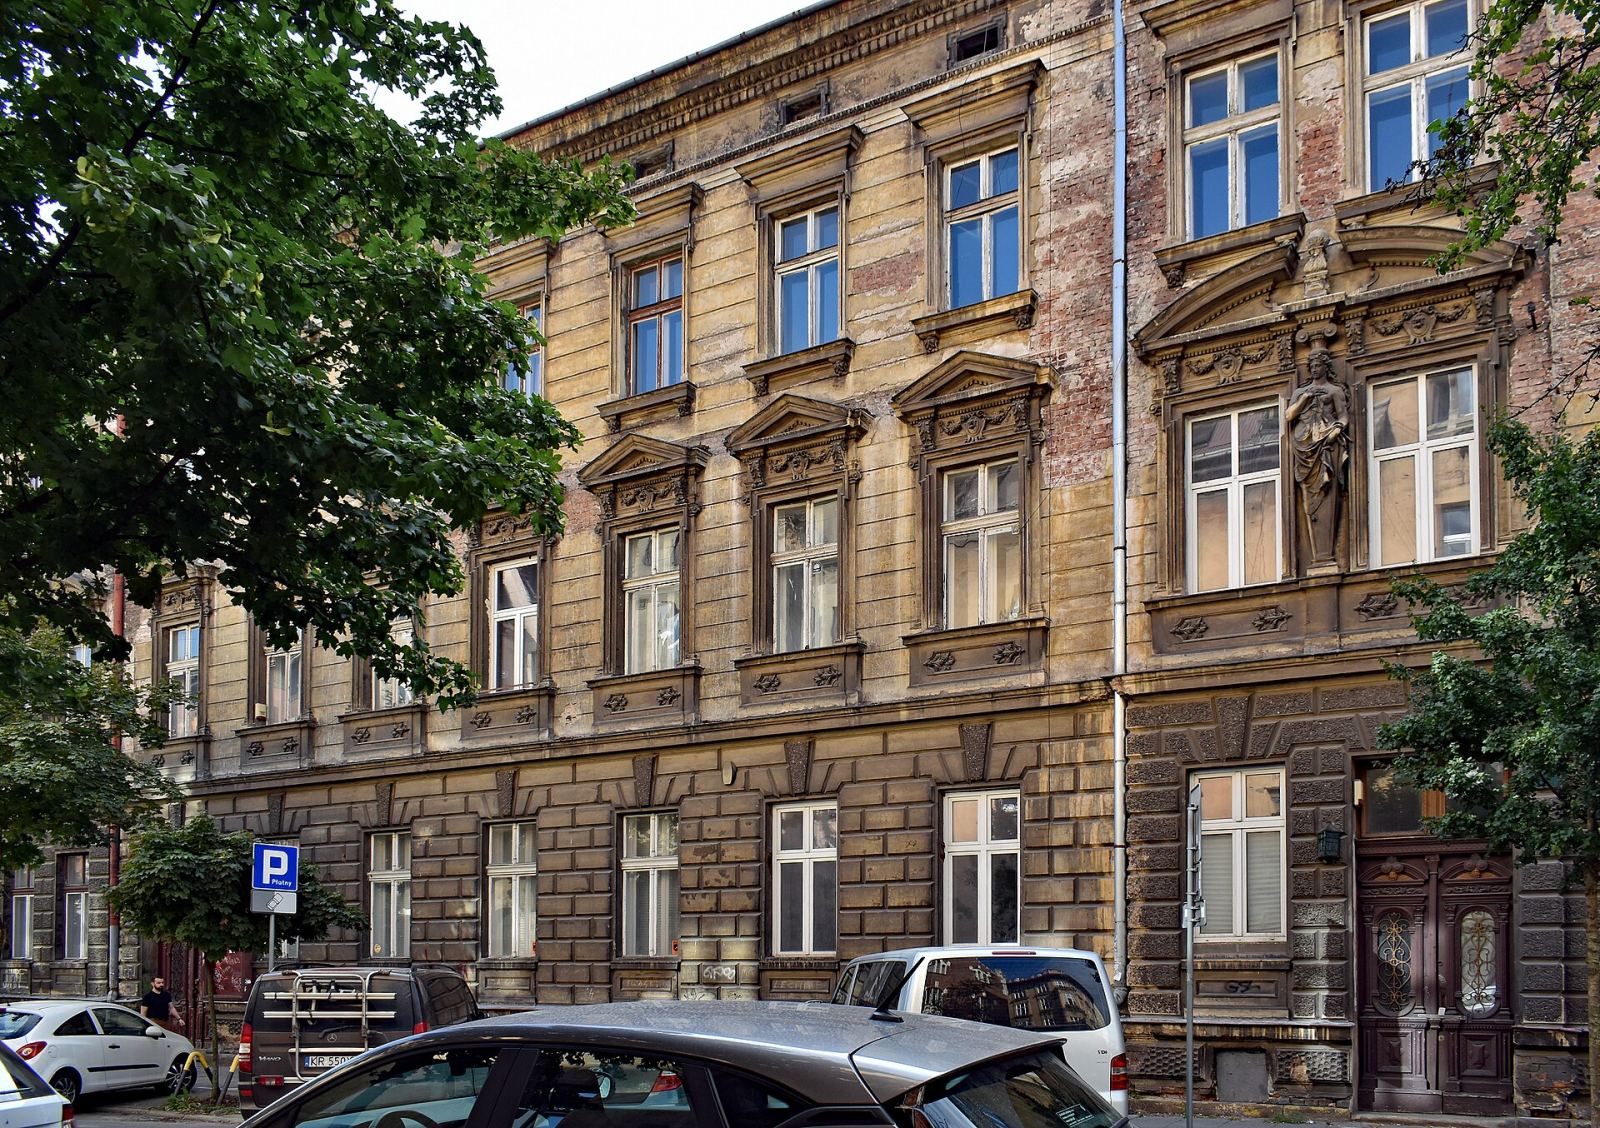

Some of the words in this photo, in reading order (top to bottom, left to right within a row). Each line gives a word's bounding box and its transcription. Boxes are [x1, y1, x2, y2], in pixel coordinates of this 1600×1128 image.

[263, 849, 288, 884] P
[310, 1056, 326, 1066] KR
[328, 1056, 354, 1066] 550
